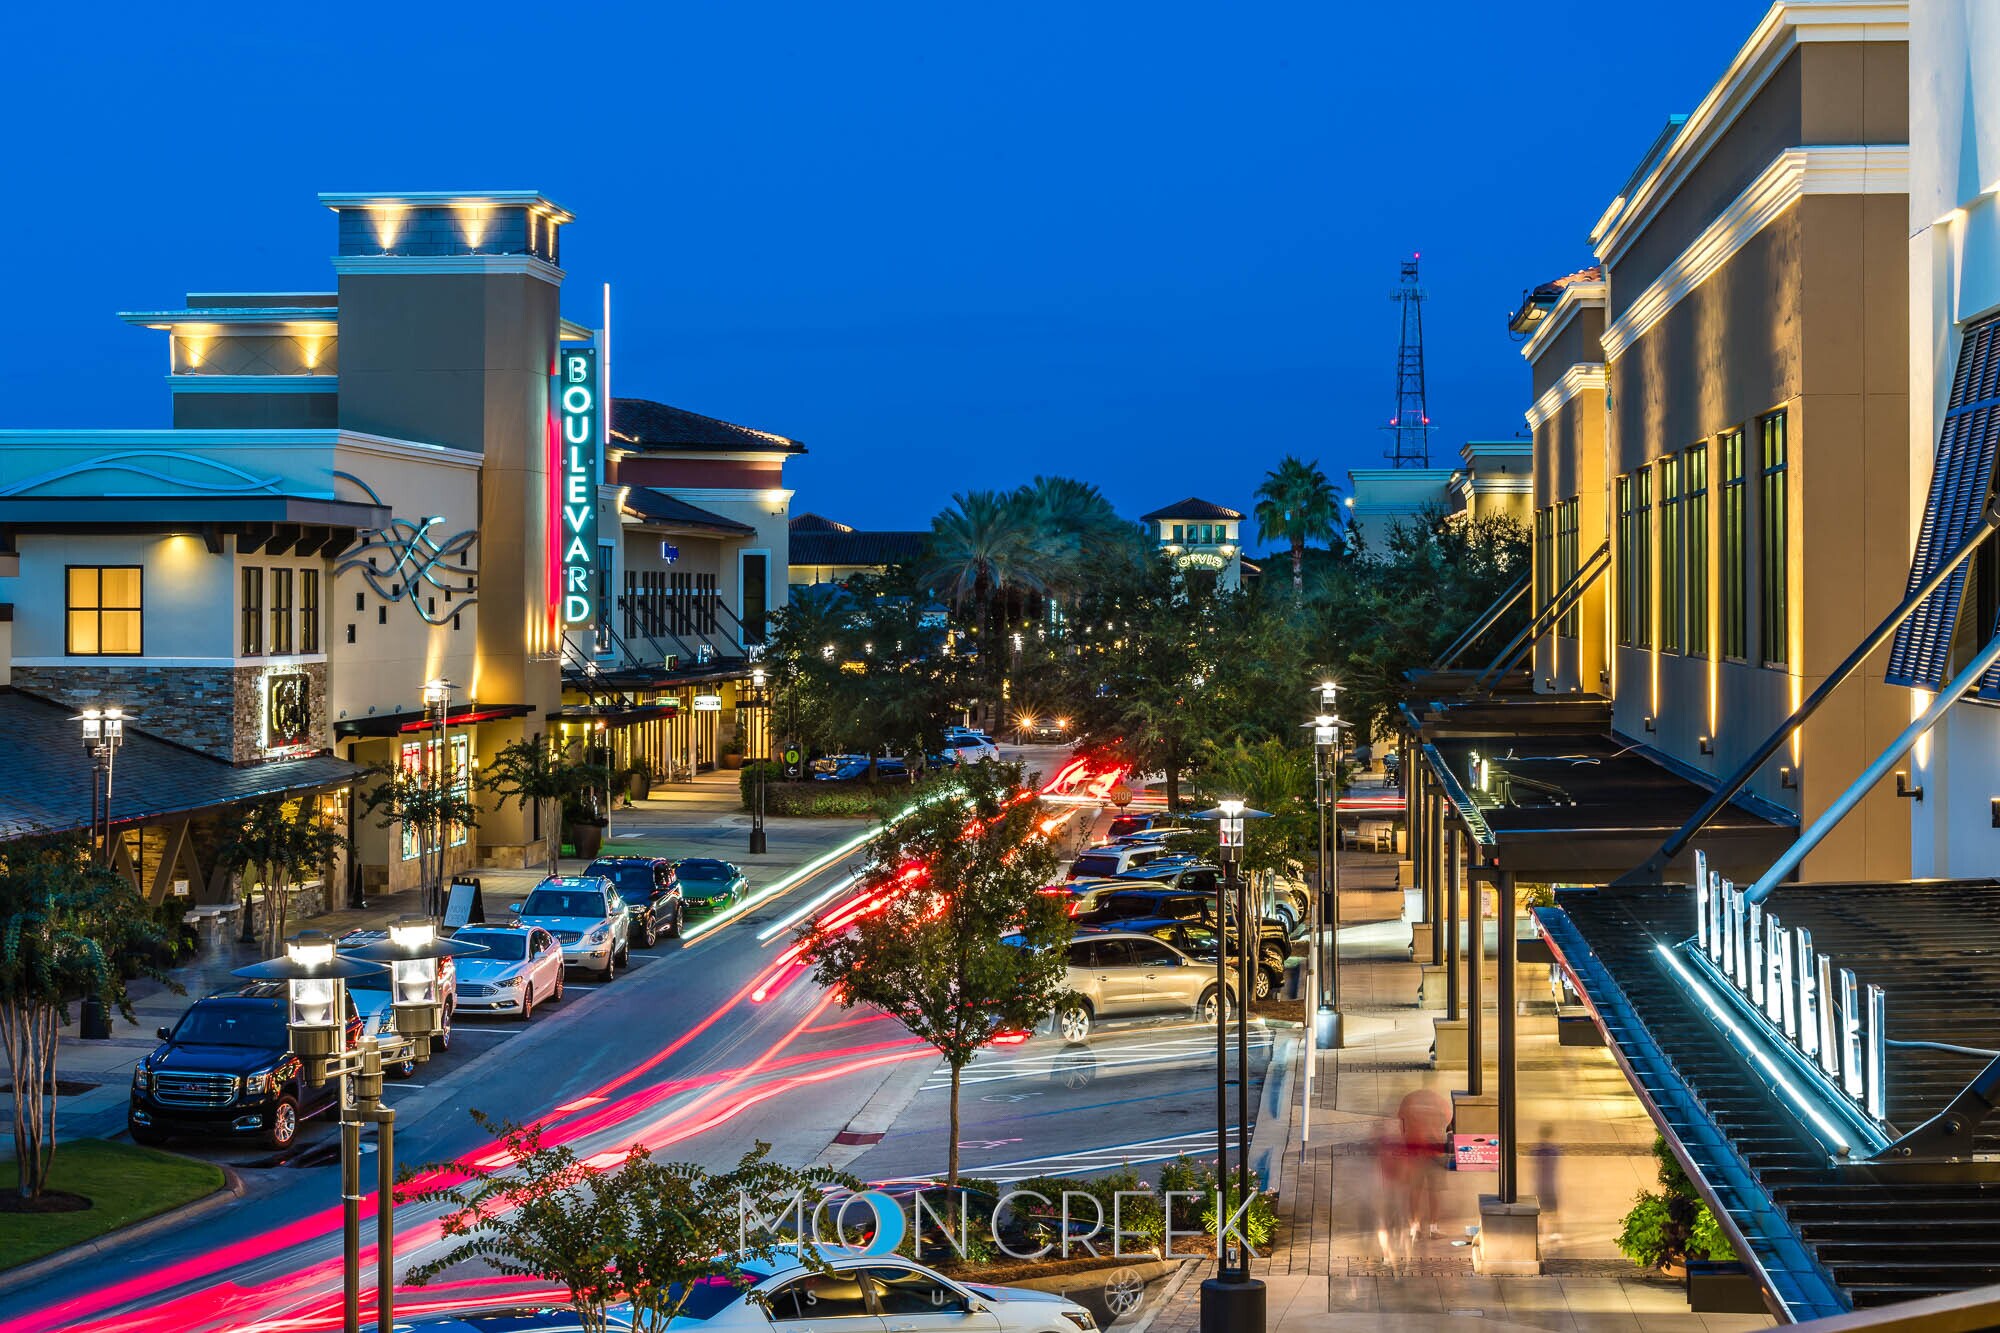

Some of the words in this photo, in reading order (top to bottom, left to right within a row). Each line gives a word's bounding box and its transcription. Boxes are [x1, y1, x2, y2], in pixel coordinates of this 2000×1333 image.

[563, 357, 592, 624] BOULEVARD
[1178, 553, 1223, 568] ORVIS
[1112, 791, 1131, 801] STOP
